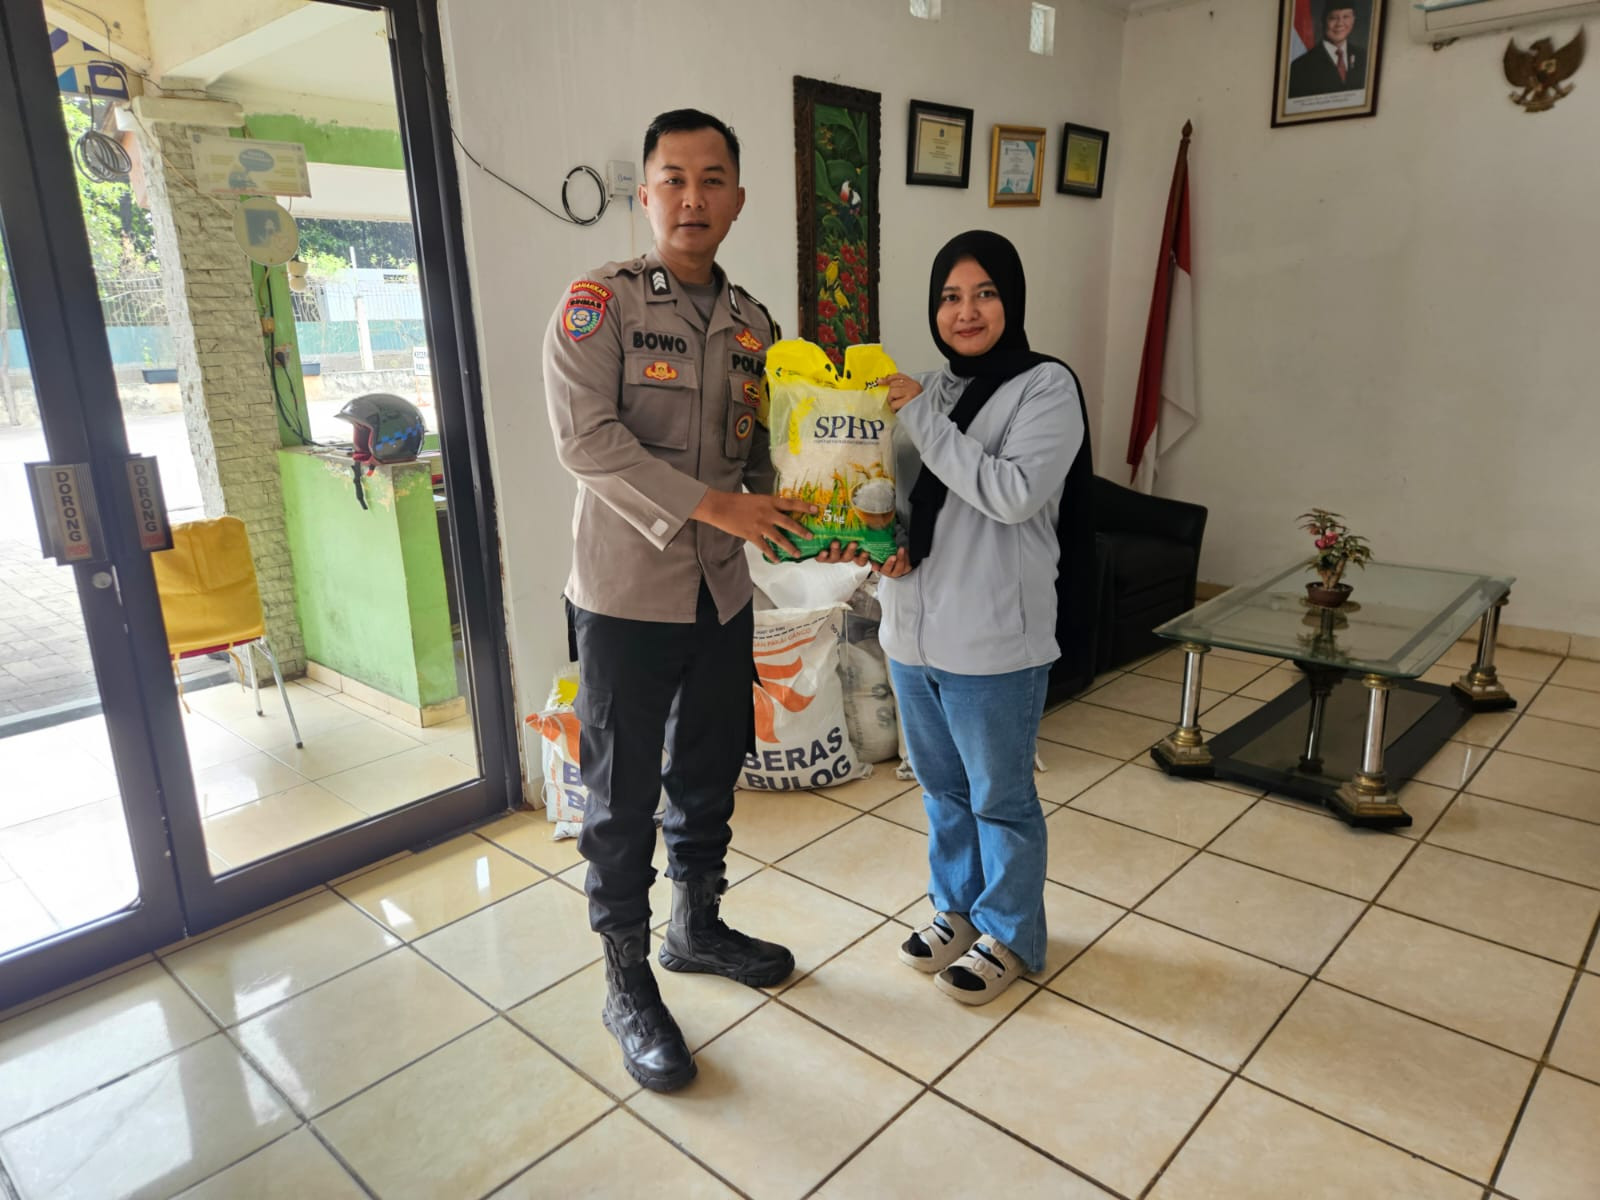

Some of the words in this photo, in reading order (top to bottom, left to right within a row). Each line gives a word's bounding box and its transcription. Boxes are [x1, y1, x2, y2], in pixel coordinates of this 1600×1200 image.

[632, 331, 688, 354] BOWO
[814, 415, 885, 440] SPHP
[57, 471, 81, 542] DORONG
[134, 465, 157, 532] DORONG
[823, 509, 832, 522] 5
[743, 726, 843, 772] BERAS
[744, 755, 851, 791] BULOG
